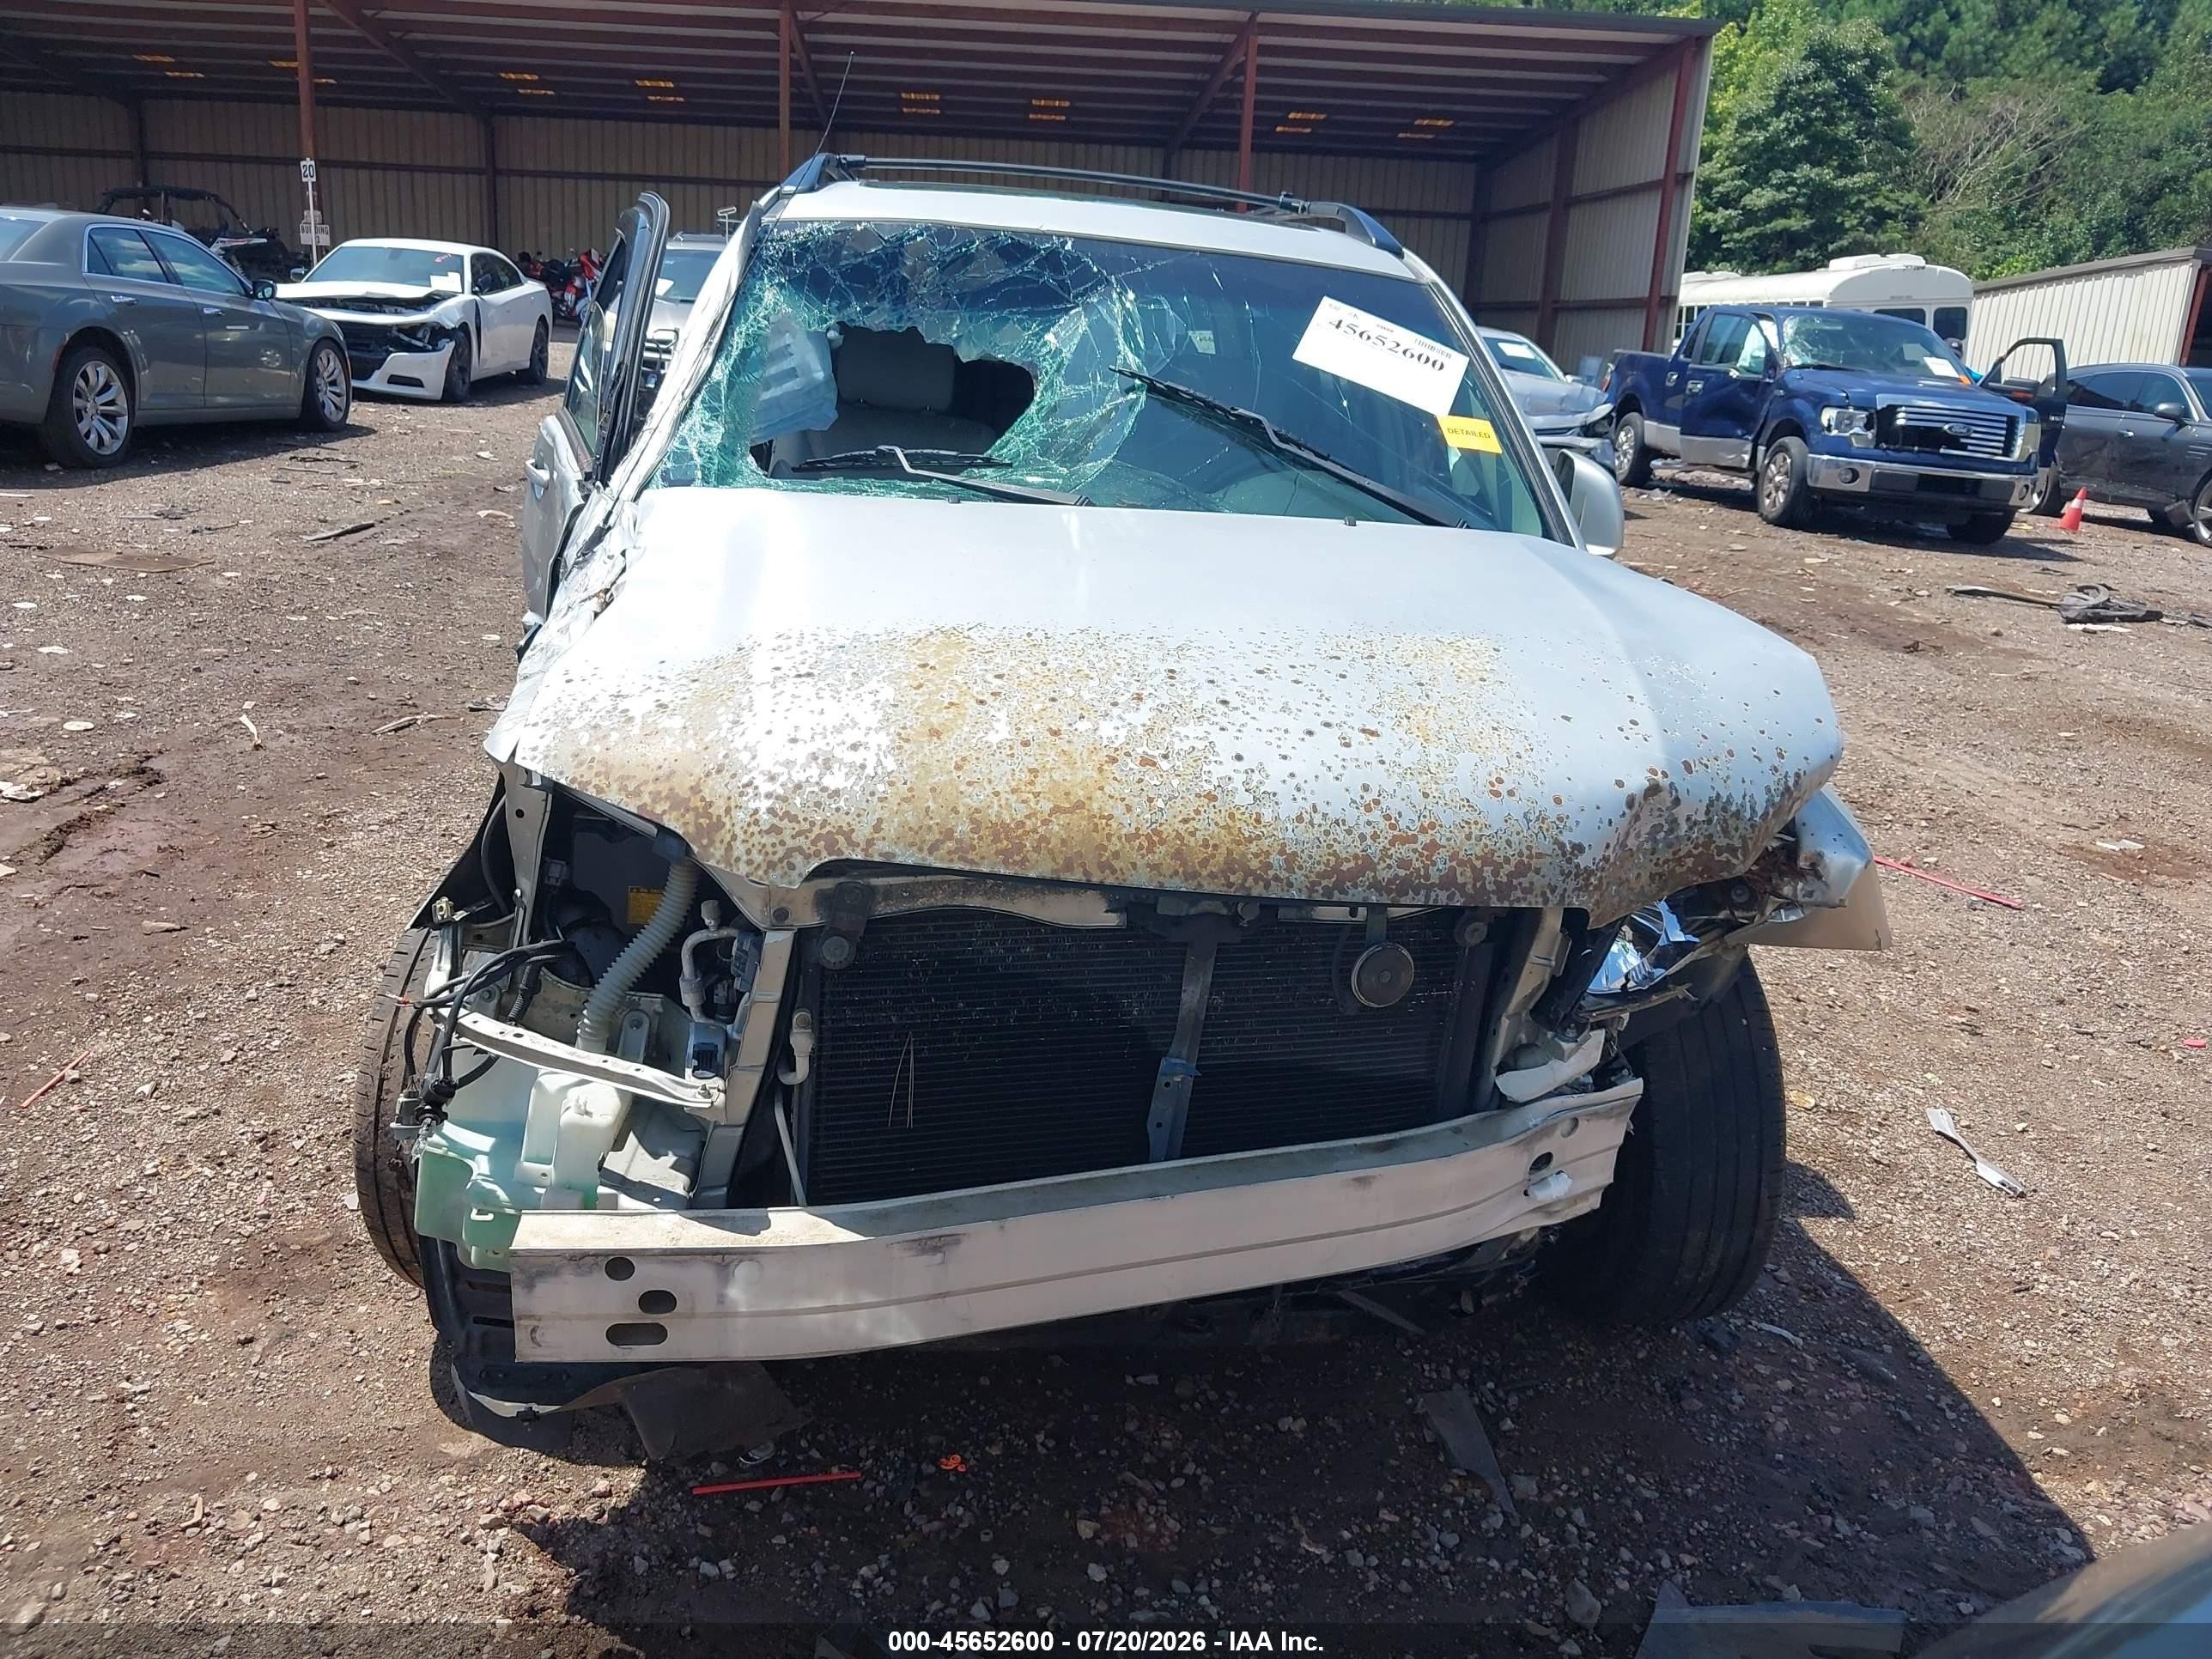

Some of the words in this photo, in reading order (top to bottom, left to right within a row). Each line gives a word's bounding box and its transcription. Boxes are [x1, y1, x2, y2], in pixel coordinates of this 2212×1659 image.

[302, 164, 314, 179] 20
[301, 225, 329, 235] BUIDING
[1328, 319, 1444, 372] 45652600
[1447, 428, 1491, 439] DETAILED
